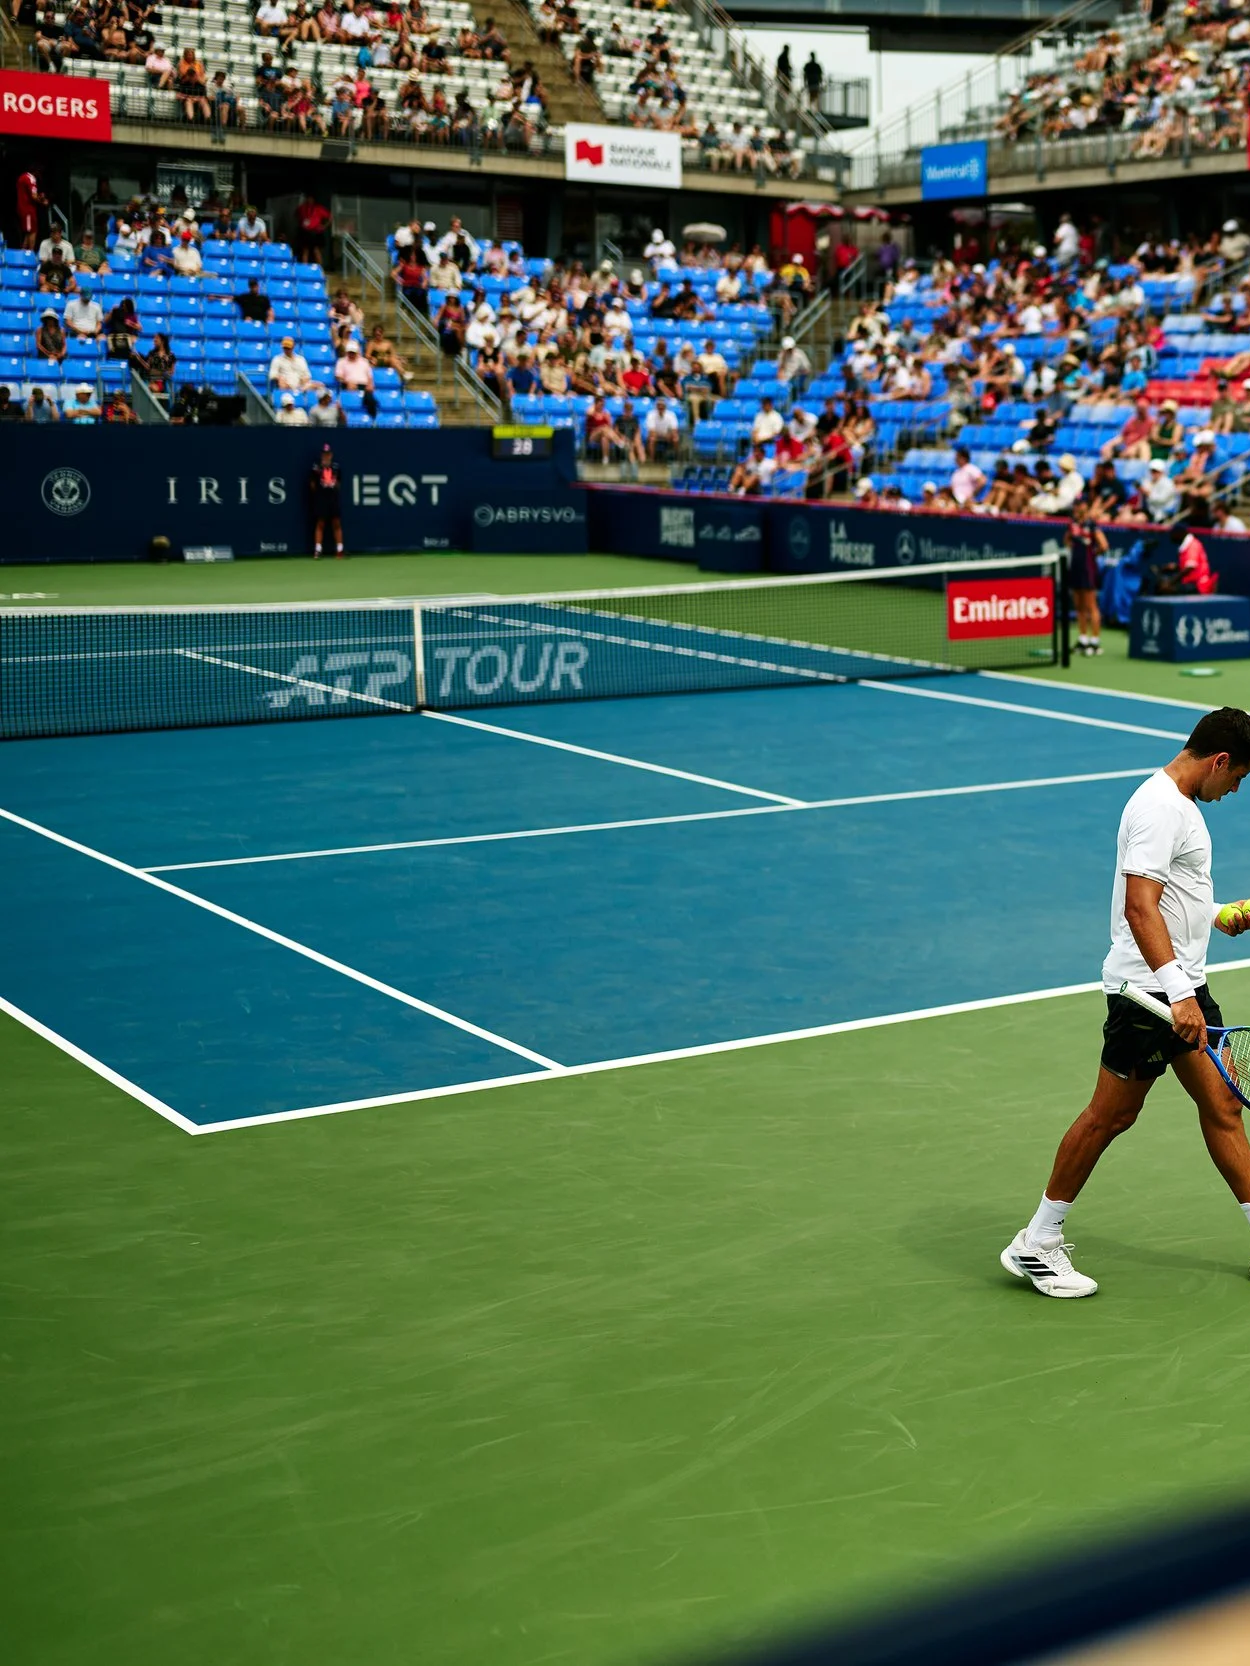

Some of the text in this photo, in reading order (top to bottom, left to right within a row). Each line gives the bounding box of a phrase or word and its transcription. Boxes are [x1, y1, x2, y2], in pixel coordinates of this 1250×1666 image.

[3, 91, 98, 119] ROGERS
[609, 143, 656, 157] BANQUE
[609, 157, 672, 171] NATIONALE
[167, 476, 287, 505] IRIS
[352, 474, 449, 506] EQT
[495, 507, 575, 523] ABRYSVO
[829, 518, 848, 540] LA
[829, 541, 875, 566] PRESSE
[953, 594, 1050, 624] Emirates
[258, 640, 590, 709] ATP TOUR
